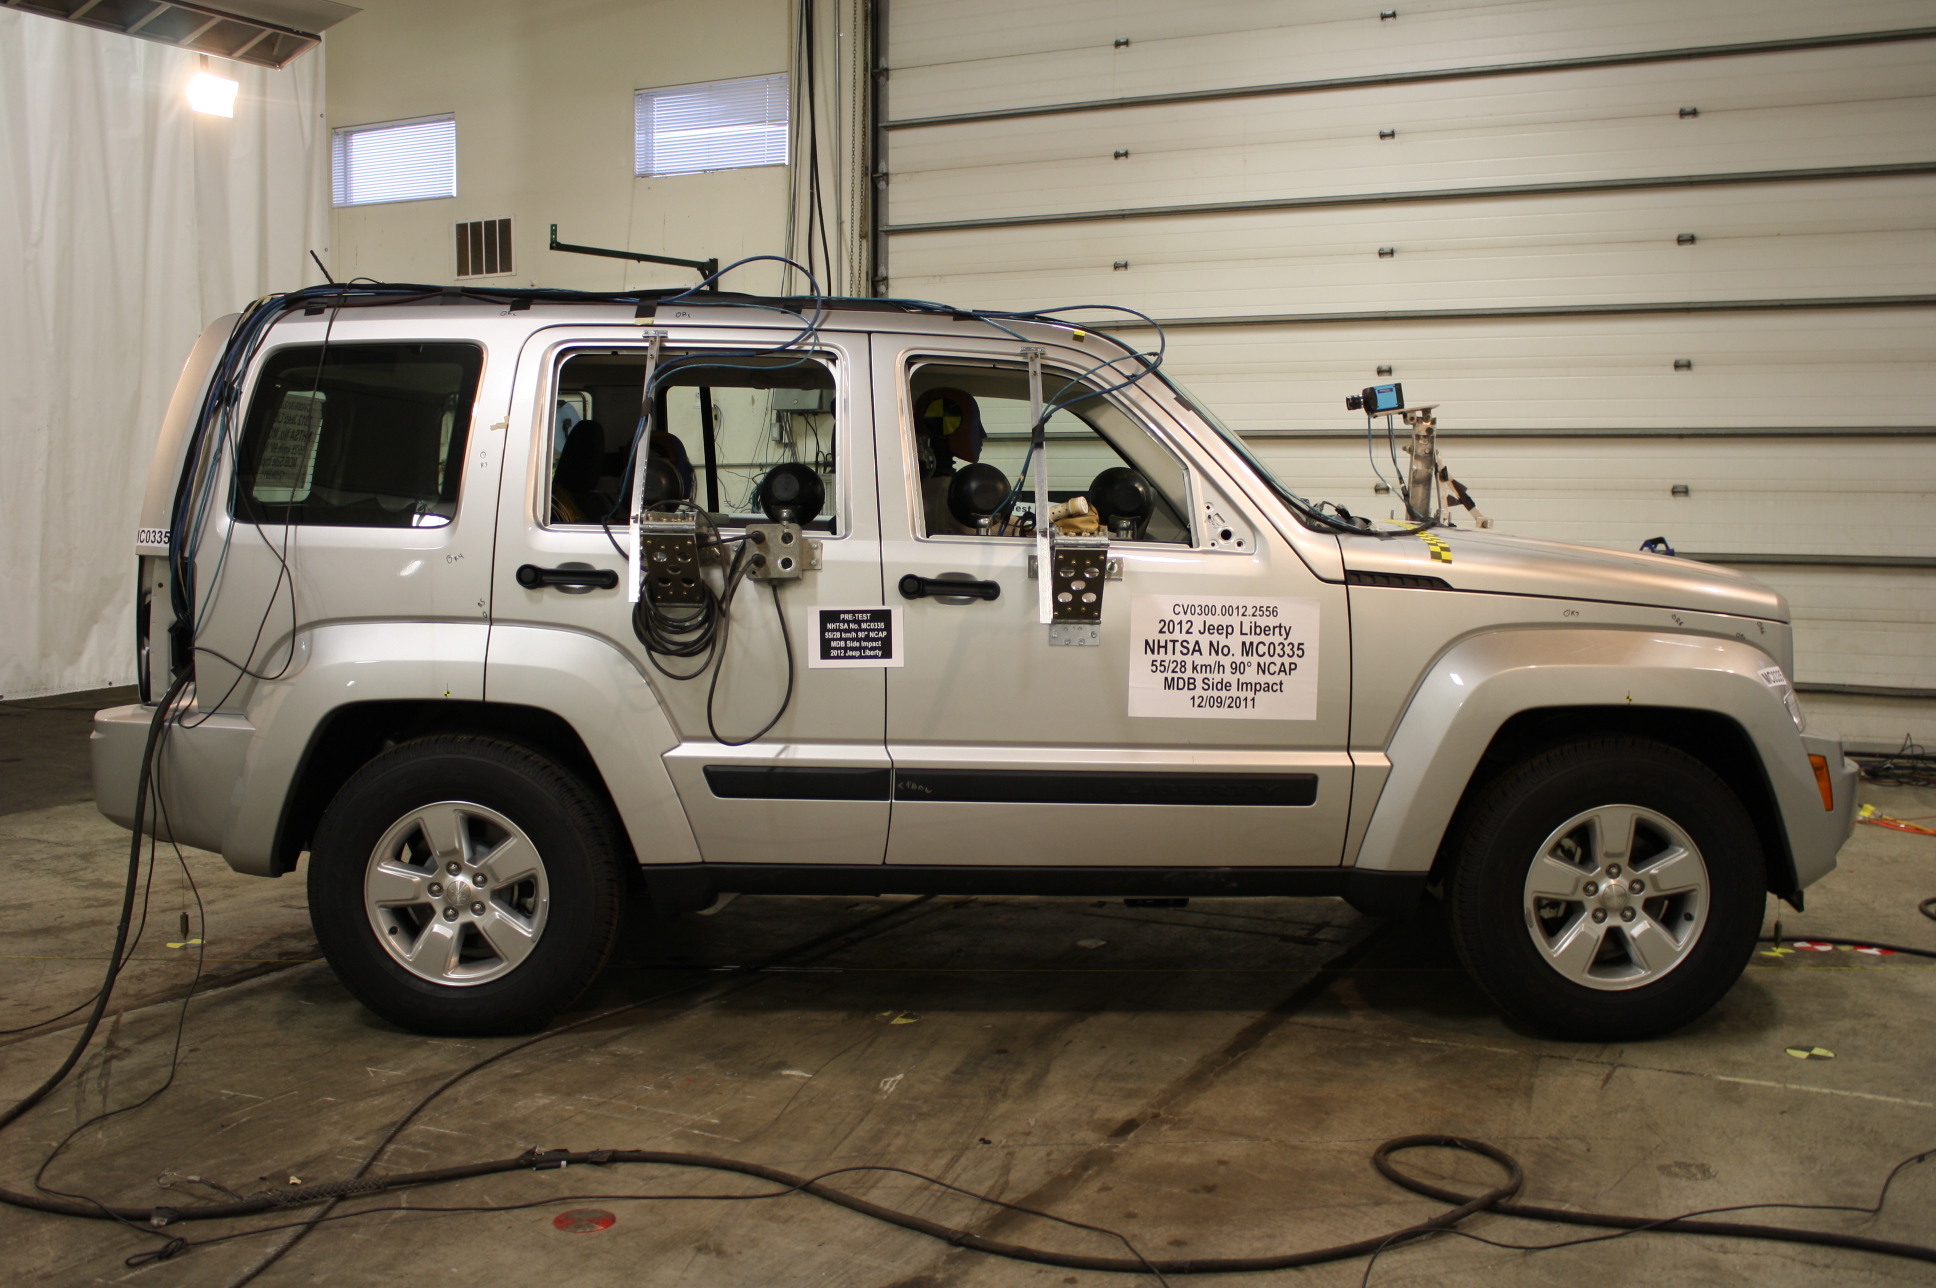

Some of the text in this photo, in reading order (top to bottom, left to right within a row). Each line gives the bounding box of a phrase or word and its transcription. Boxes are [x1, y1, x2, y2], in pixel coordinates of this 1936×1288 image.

[137, 529, 170, 545] C0335
[1172, 604, 1279, 618] CV0300.0012.2556
[1158, 619, 1292, 640] 2012 Jeep Liberty
[861, 640, 881, 648] Impact
[1144, 639, 1305, 658] NHTSA No. MC0335
[861, 649, 882, 657] Liberty
[1150, 659, 1297, 676] 55/28 km/h 90° NCAP
[1164, 677, 1284, 695] MDB Side Impact
[1190, 696, 1255, 709] 12/09/2011
